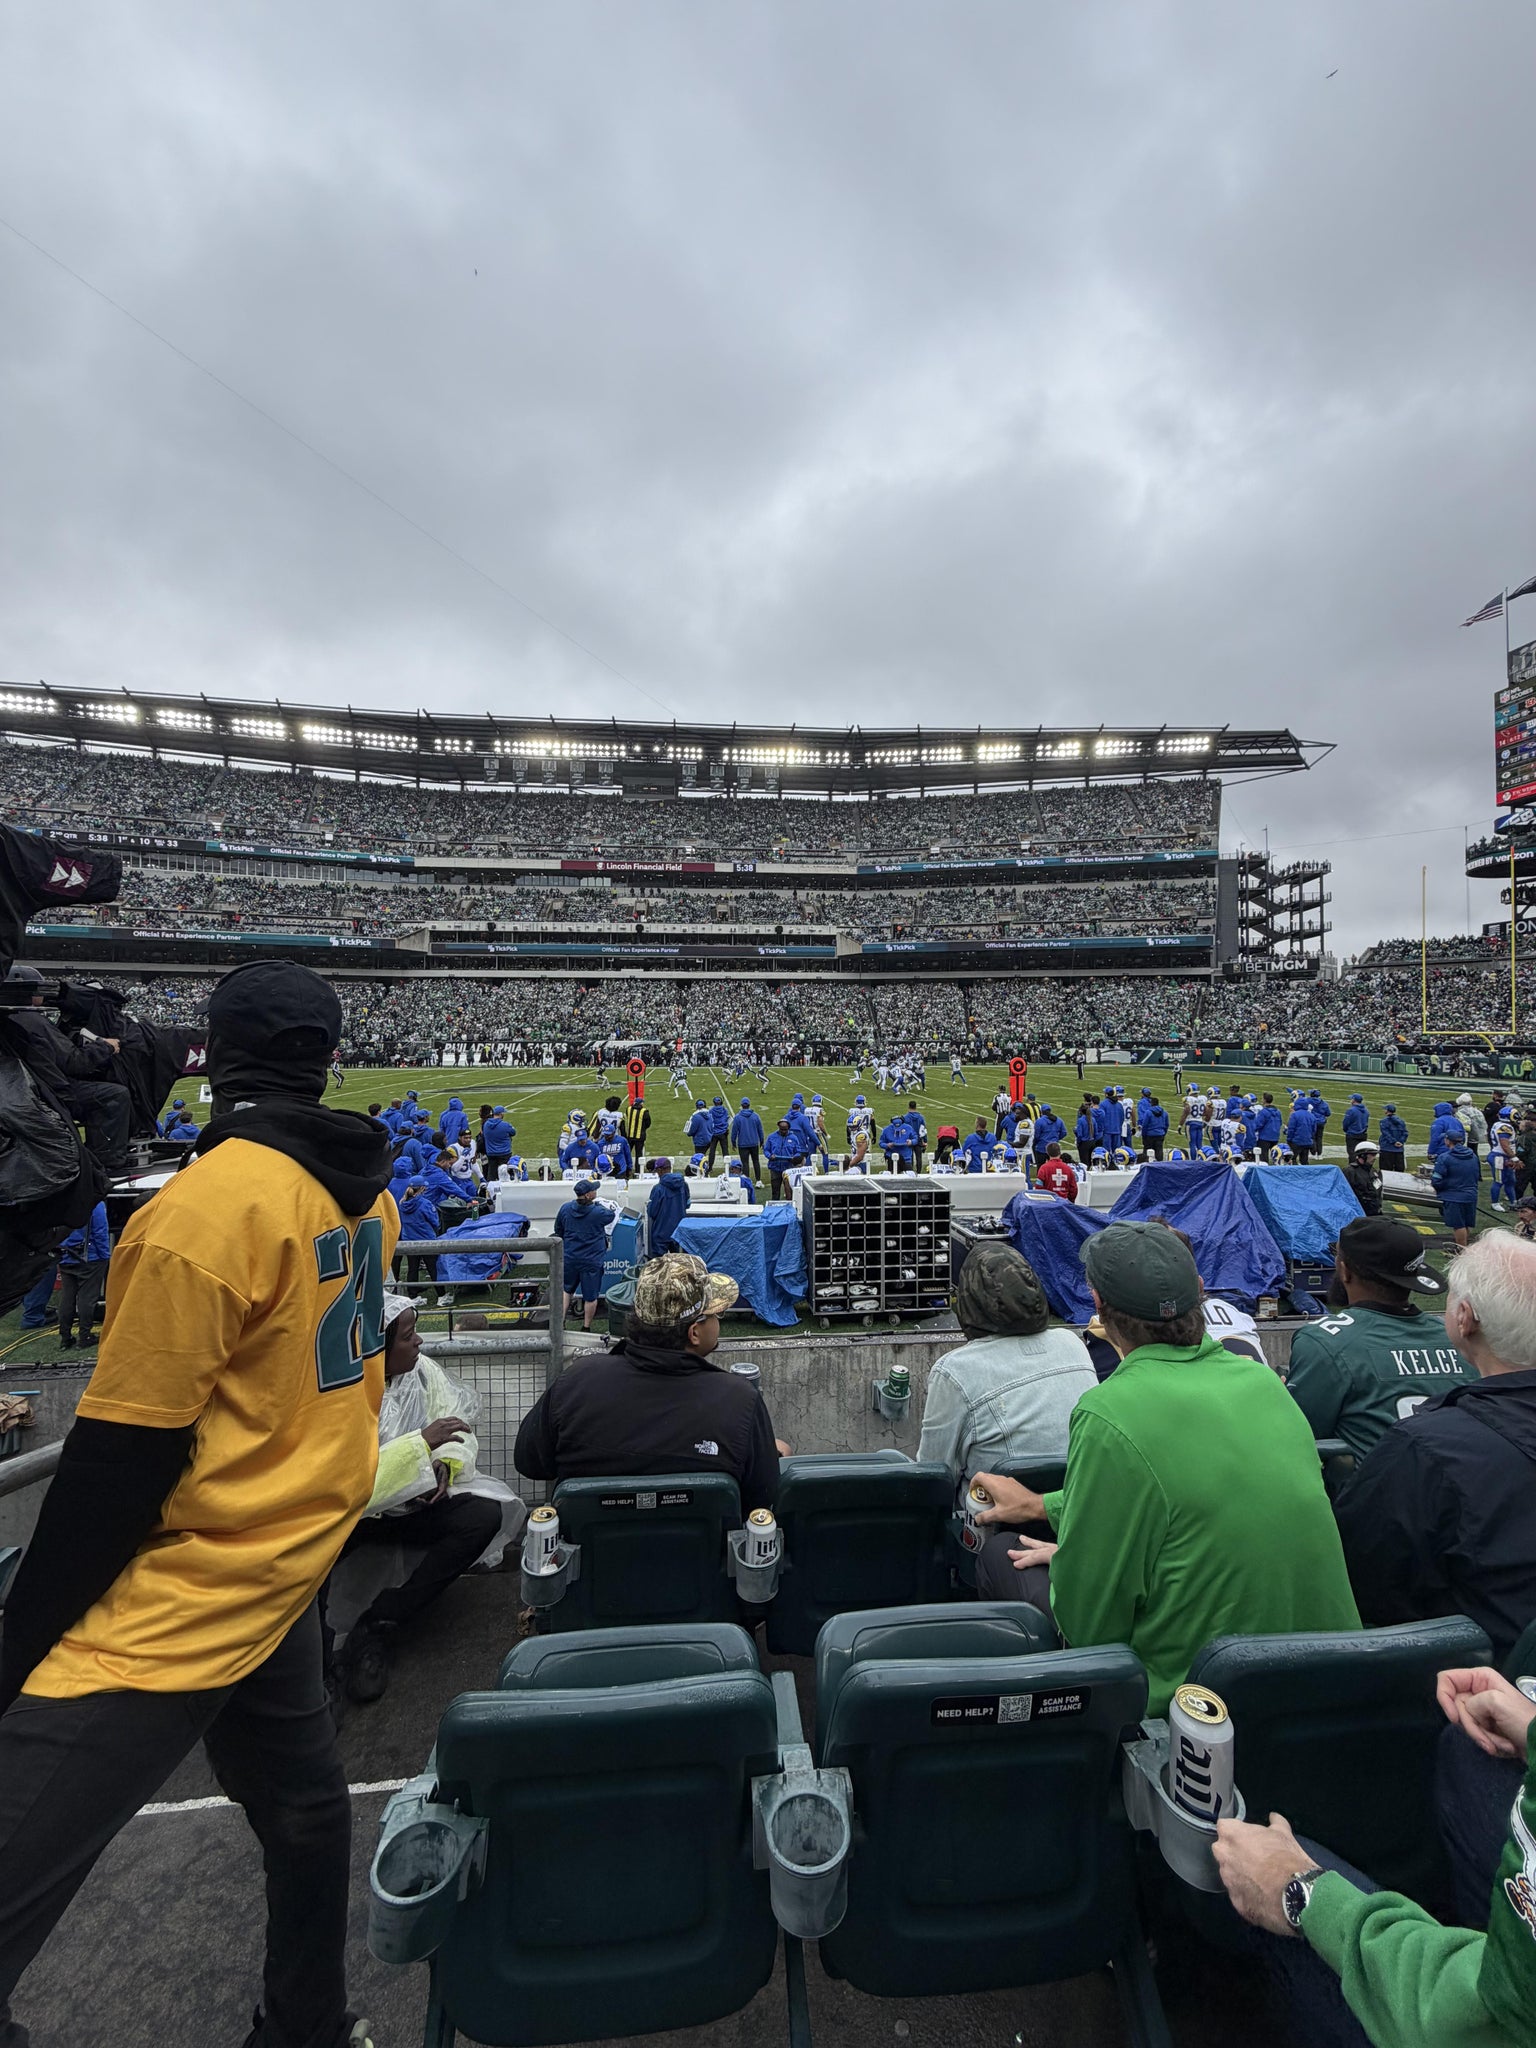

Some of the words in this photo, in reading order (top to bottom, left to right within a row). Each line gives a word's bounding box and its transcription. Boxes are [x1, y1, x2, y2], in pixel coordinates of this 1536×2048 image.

[228, 844, 254, 852] TickPick
[304, 850, 336, 858] Experience
[1495, 851, 1534, 862] verzon
[376, 856, 400, 864] TickPick
[25, 926, 46, 934] Pick
[176, 932, 215, 940] Experience
[340, 938, 372, 946] TickPick
[1246, 960, 1308, 972] BETMGM
[602, 1143, 622, 1152] RAMS
[313, 1216, 385, 1393] 24
[1202, 1304, 1233, 1326] LD
[1390, 1349, 1464, 1376] KELCE
[1042, 1698, 1064, 1706] SCAN
[936, 1710, 962, 1718] NEED
[965, 1707, 994, 1717] HELP?
[1038, 1703, 1082, 1714] ASSISTANCE
[1174, 1736, 1222, 1824] Lite
